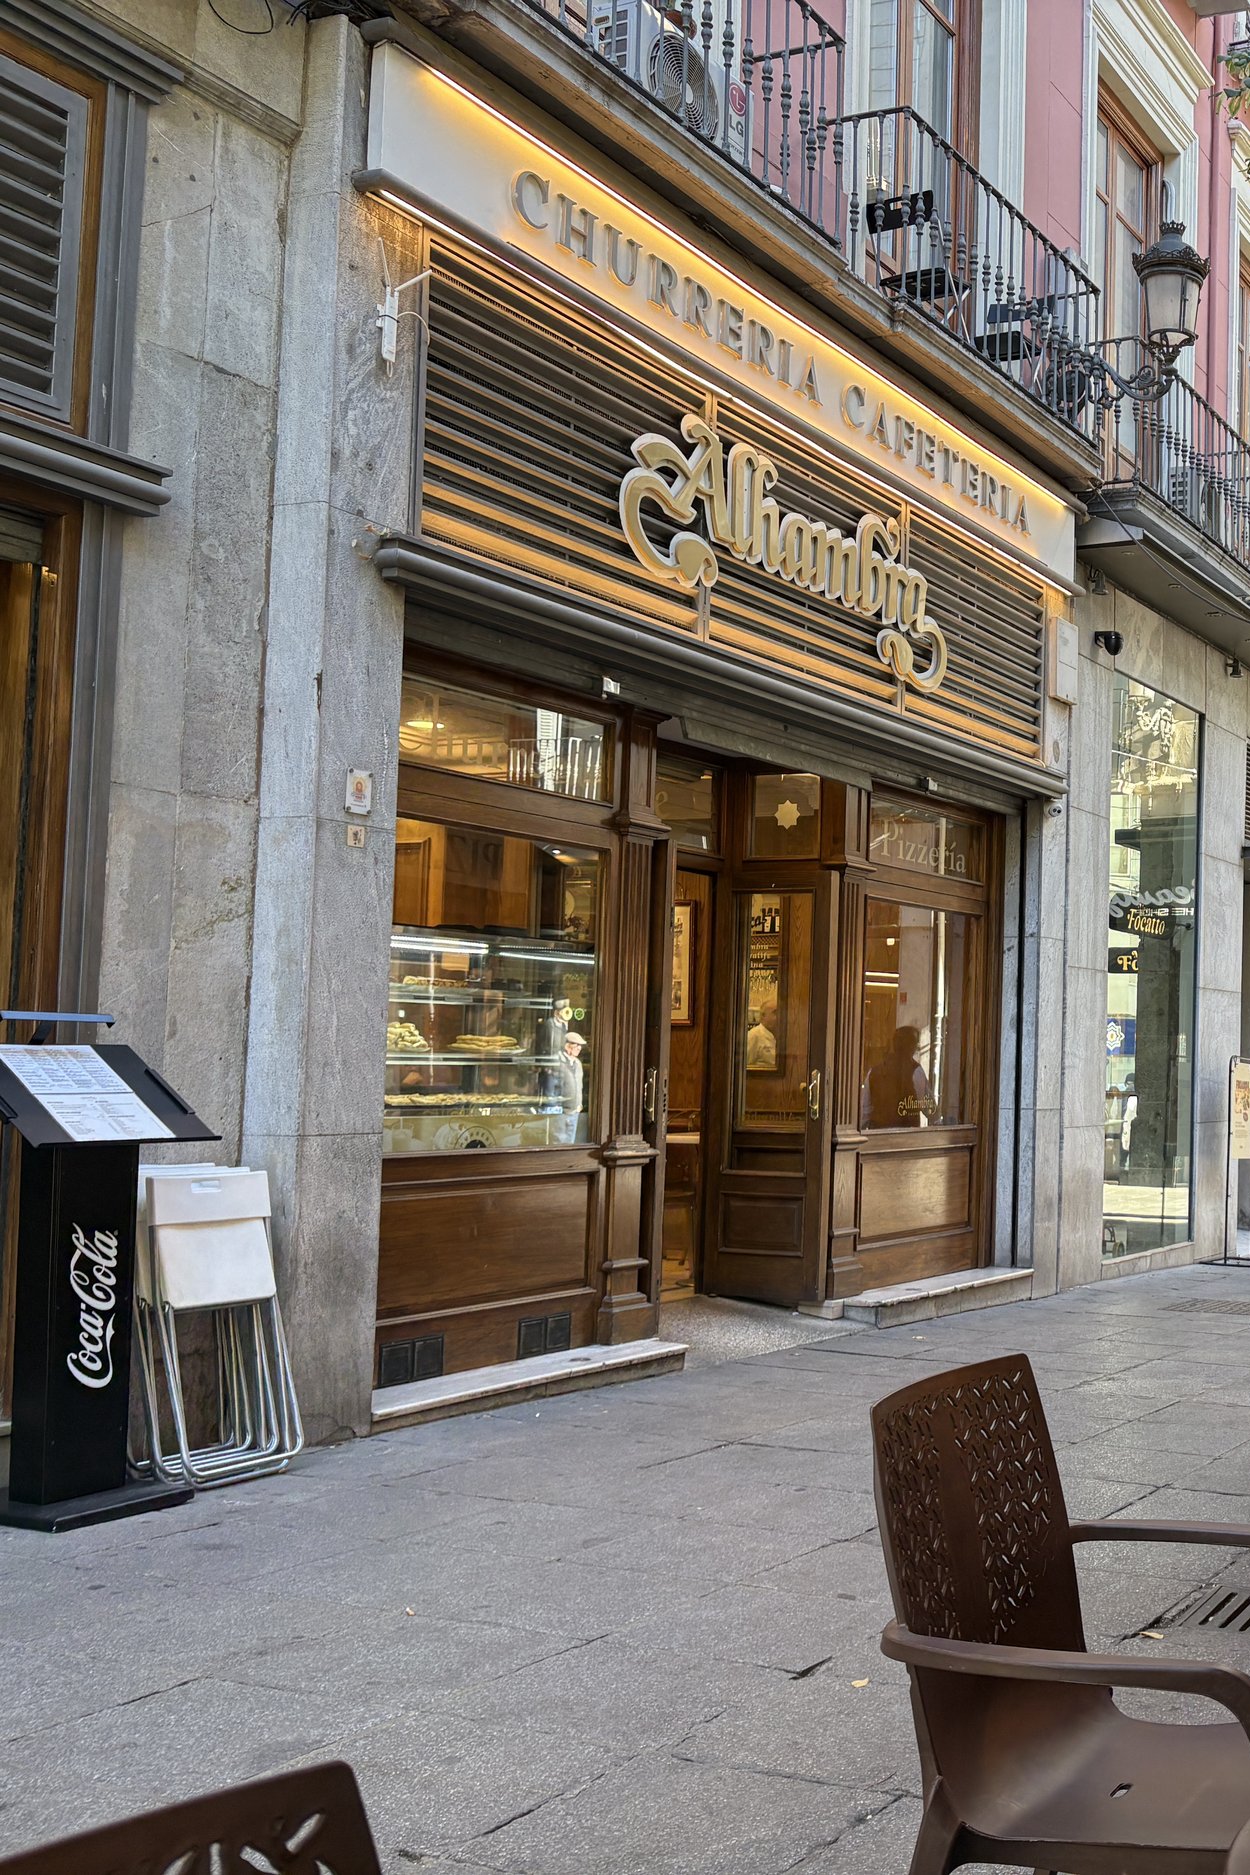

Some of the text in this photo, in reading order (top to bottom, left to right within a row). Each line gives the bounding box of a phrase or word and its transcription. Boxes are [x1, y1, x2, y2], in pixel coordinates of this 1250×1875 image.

[729, 114, 744, 138] LG
[512, 170, 1032, 537] CHURRERIA CAFETERIA
[619, 413, 948, 693] Alhambra
[880, 818, 967, 873] Pizzería
[66, 1222, 119, 1389] Coca-Cola
